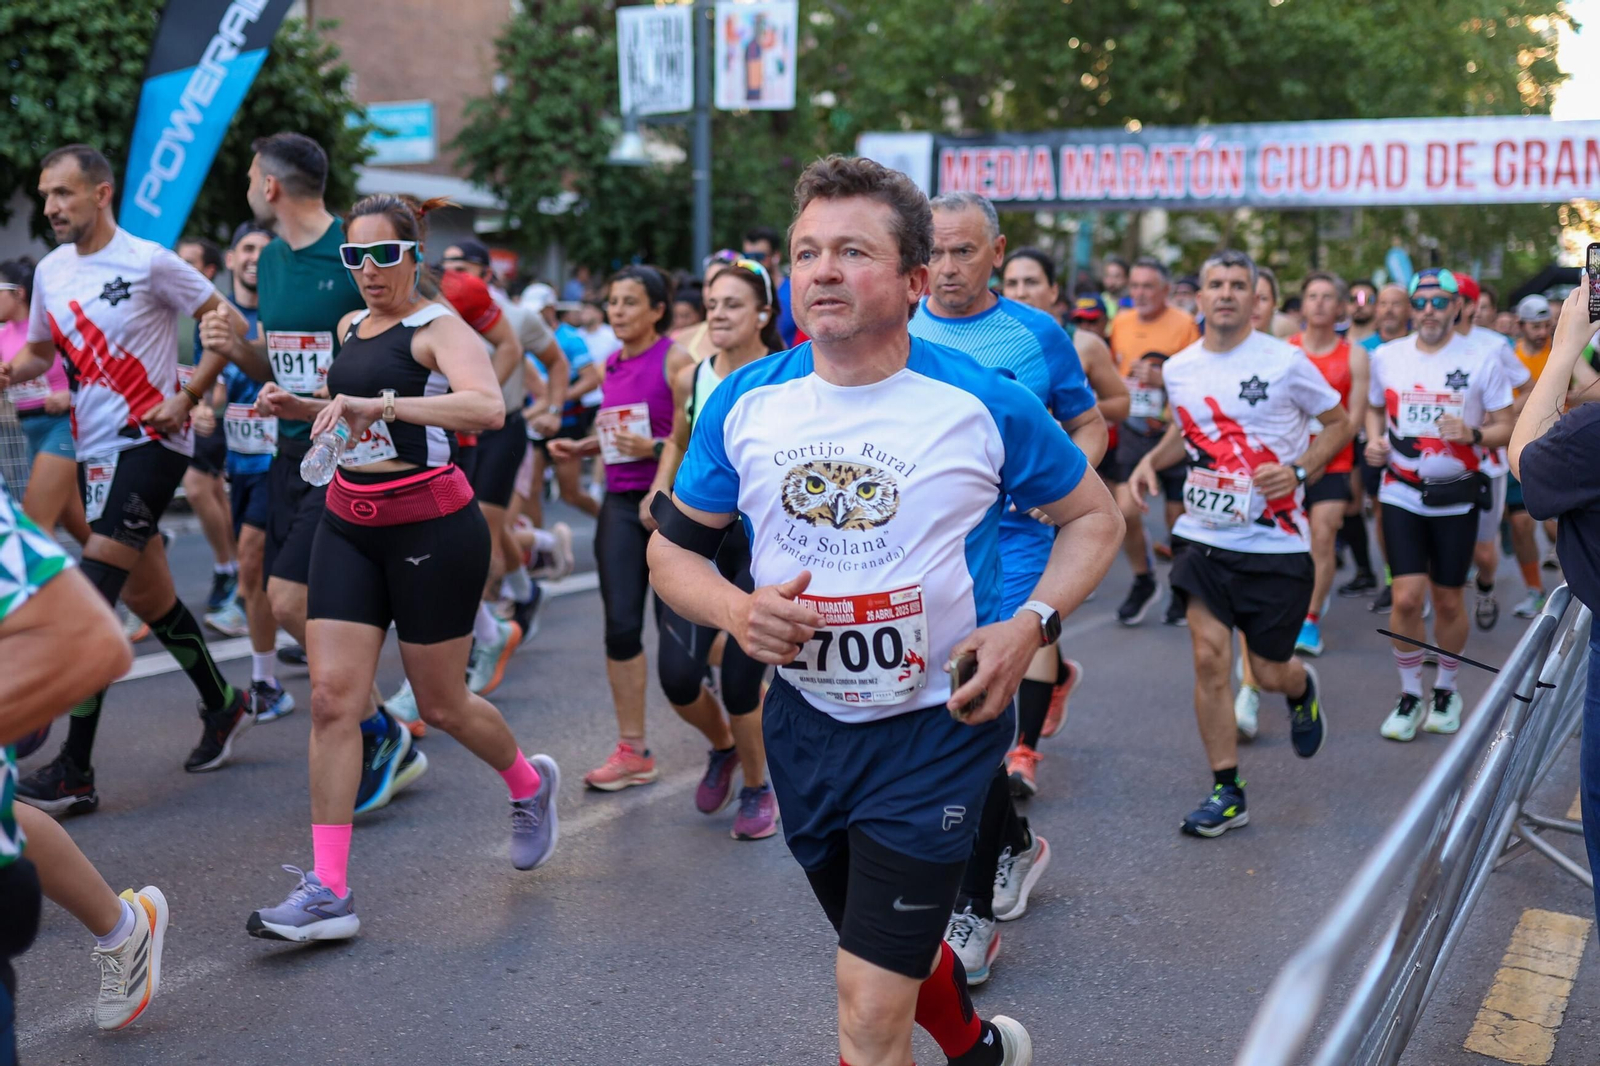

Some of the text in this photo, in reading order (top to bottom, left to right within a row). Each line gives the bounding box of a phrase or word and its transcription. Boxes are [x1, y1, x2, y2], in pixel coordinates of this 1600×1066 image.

[940, 146, 1055, 199] MEDIA
[1060, 134, 1244, 198] MARATÓN
[1260, 142, 1408, 192] CIUDAD
[1425, 141, 1476, 189] DE
[272, 352, 318, 374] 1911
[773, 441, 917, 478] Cortijo Rural
[1187, 487, 1235, 514] 4272
[818, 599, 854, 614] MARATÓN
[875, 607, 895, 621] ABRIL
[826, 613, 856, 624] GRANADA
